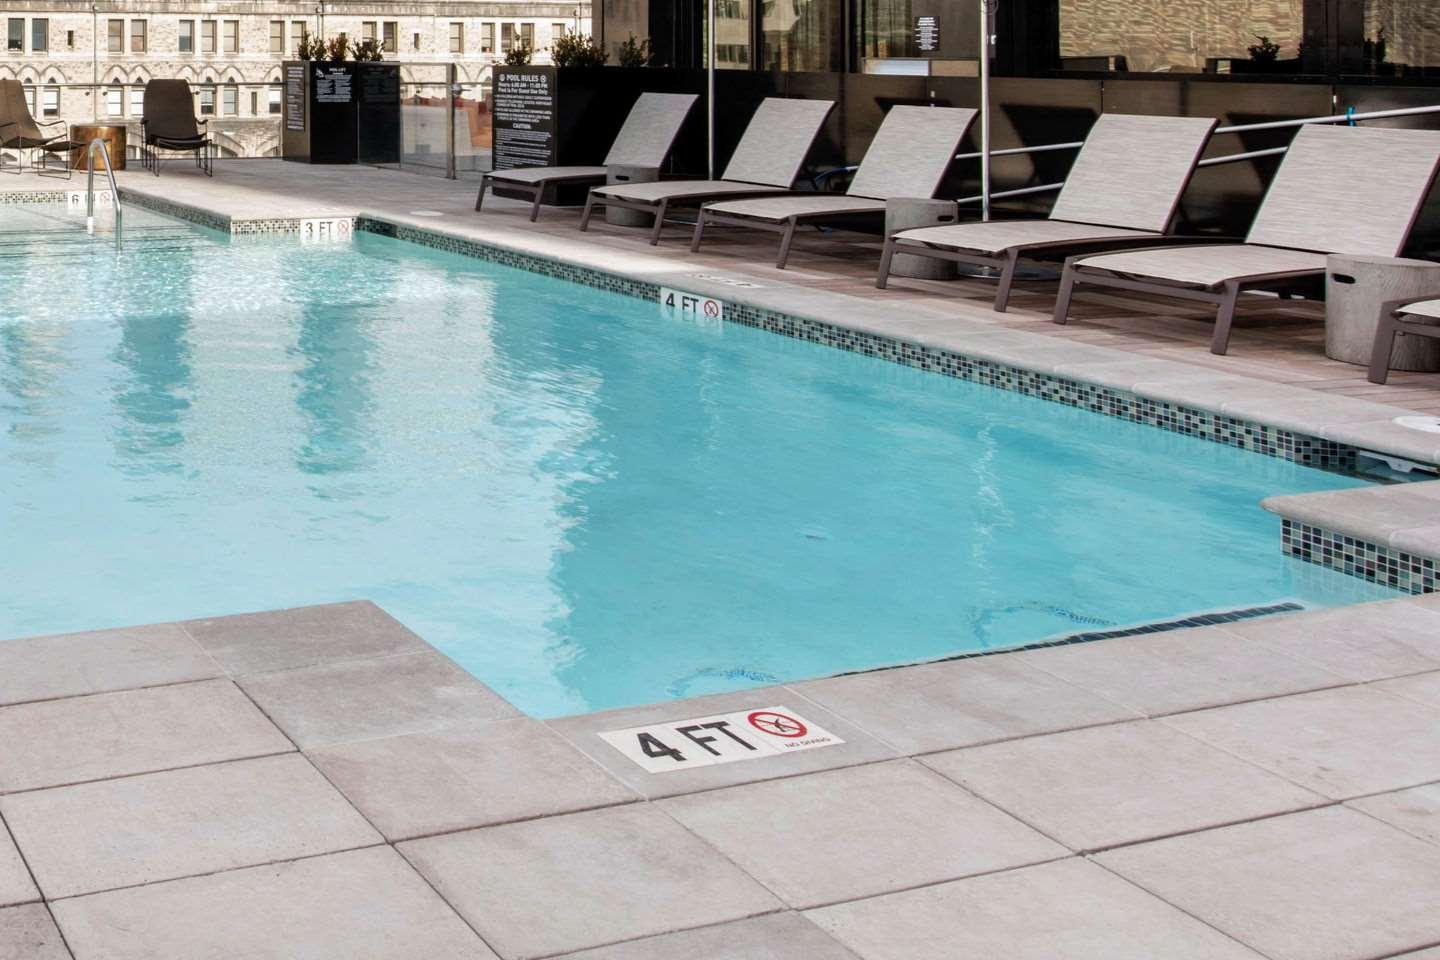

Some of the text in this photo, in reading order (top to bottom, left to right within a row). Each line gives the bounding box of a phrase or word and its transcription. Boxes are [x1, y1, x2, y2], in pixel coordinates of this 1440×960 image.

[506, 74, 539, 82] POOL RULES
[305, 221, 333, 233] 3 FT
[665, 292, 699, 313] 4 FT
[636, 720, 758, 762] 4 FT
